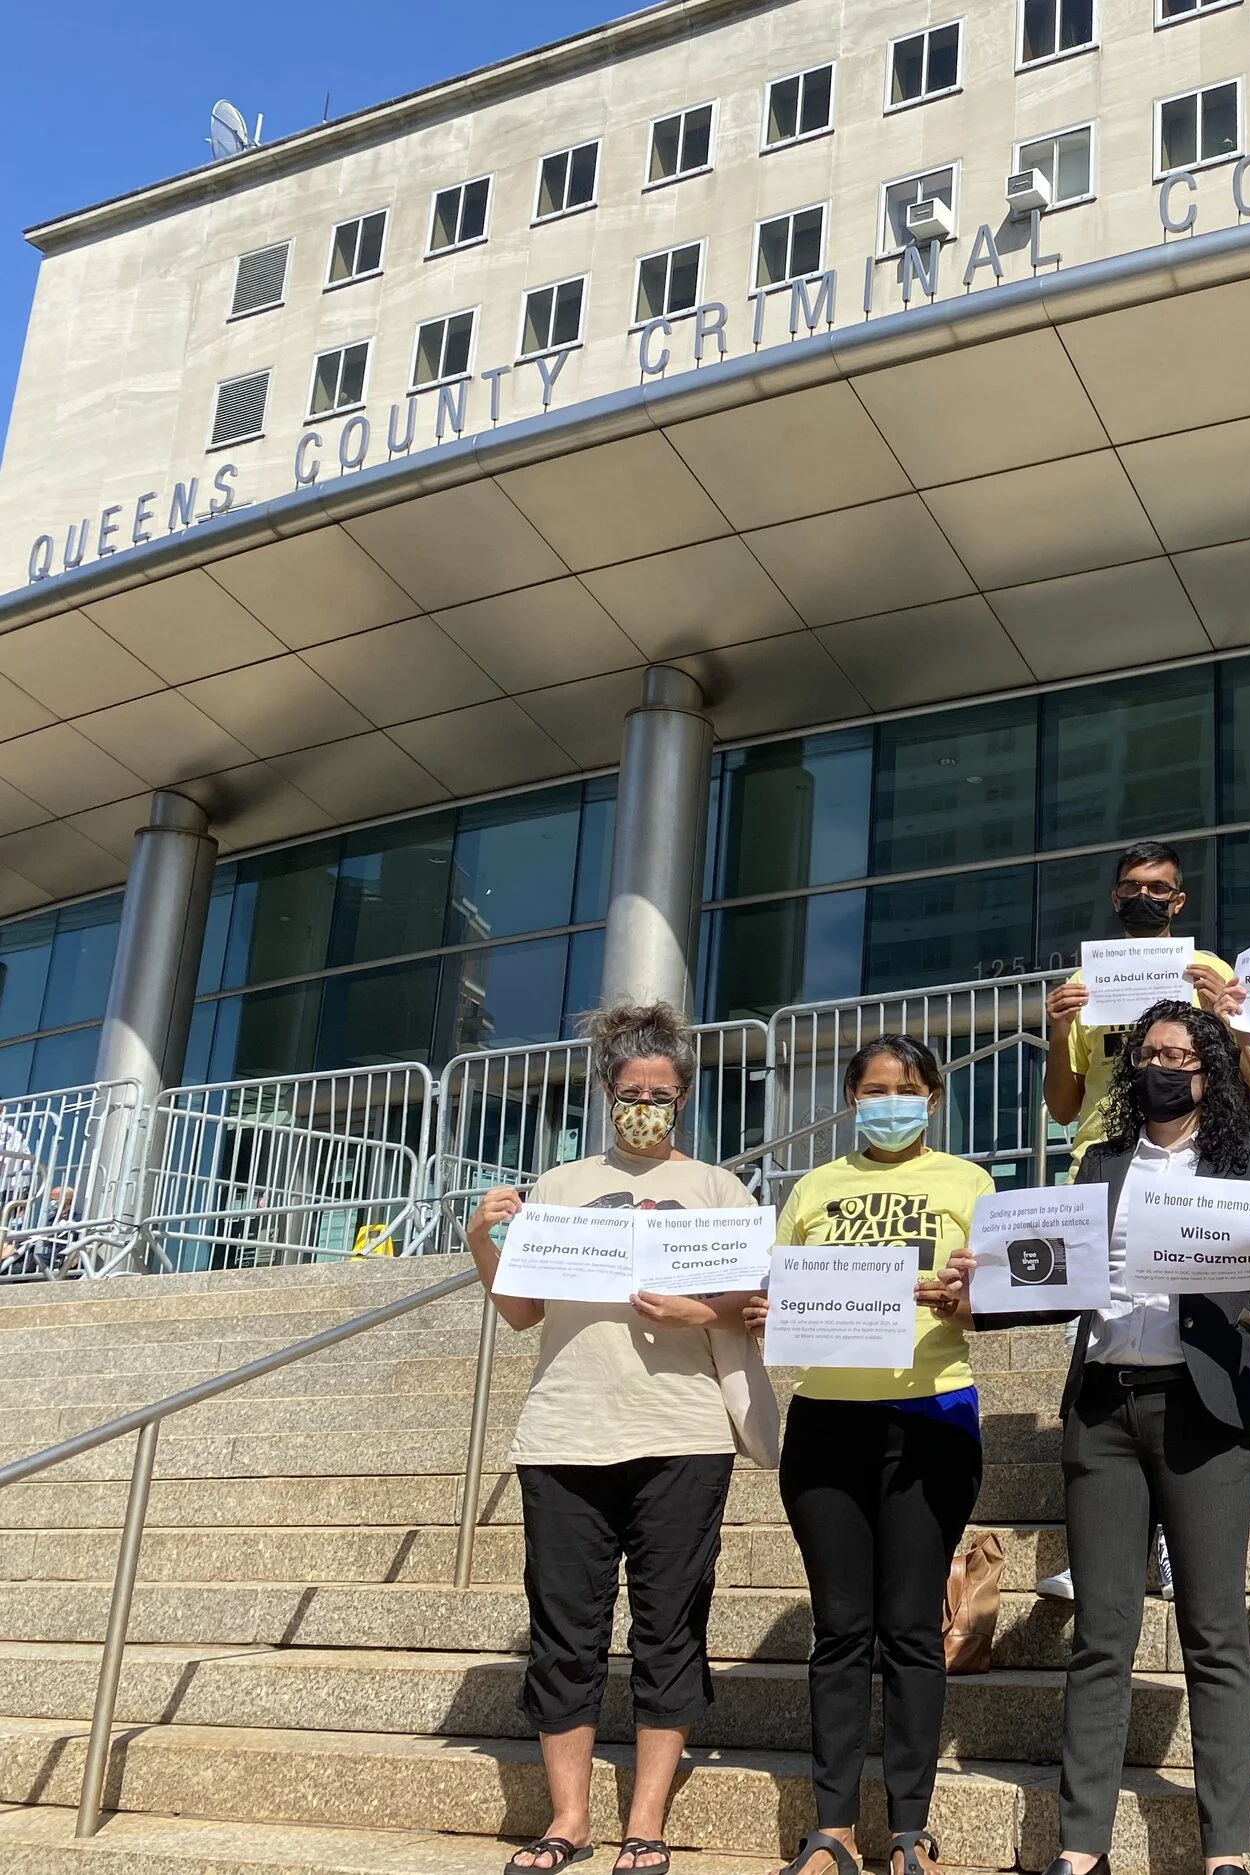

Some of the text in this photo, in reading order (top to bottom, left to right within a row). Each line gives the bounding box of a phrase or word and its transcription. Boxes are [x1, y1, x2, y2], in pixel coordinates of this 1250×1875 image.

[28, 464, 239, 581] QUEENS
[295, 350, 569, 485] COUNTY
[640, 210, 1062, 375] CRIMINAL
[1092, 945, 1184, 959] We honor the memory of
[1095, 971, 1179, 984] Isa Abdul Karim
[1145, 1191, 1160, 1205] We
[1163, 1193, 1194, 1207] honor
[1196, 1196, 1214, 1209] the
[989, 1208, 1011, 1219] Sending
[1017, 1208, 1037, 1217] person
[1039, 1205, 1046, 1214] to
[1047, 1206, 1058, 1214] any
[1059, 1204, 1072, 1214] City
[1073, 1203, 1084, 1213] jail
[526, 1211, 629, 1229] We honor the memory
[647, 1216, 763, 1229] We honor the memory of
[828, 1212, 943, 1242] WATCH
[982, 1223, 1000, 1233] facility
[1001, 1223, 1007, 1231] is
[1013, 1220, 1041, 1231] potential
[1041, 1219, 1060, 1228] death
[1061, 1218, 1090, 1227] sentence
[1180, 1226, 1231, 1241] Wilson
[522, 1243, 629, 1260] Stephan Khadu,
[662, 1241, 748, 1253] Tomas Carlo
[671, 1257, 738, 1270] Camacho
[784, 1257, 905, 1273] We honor the memory of
[780, 1299, 842, 1315] Segundo
